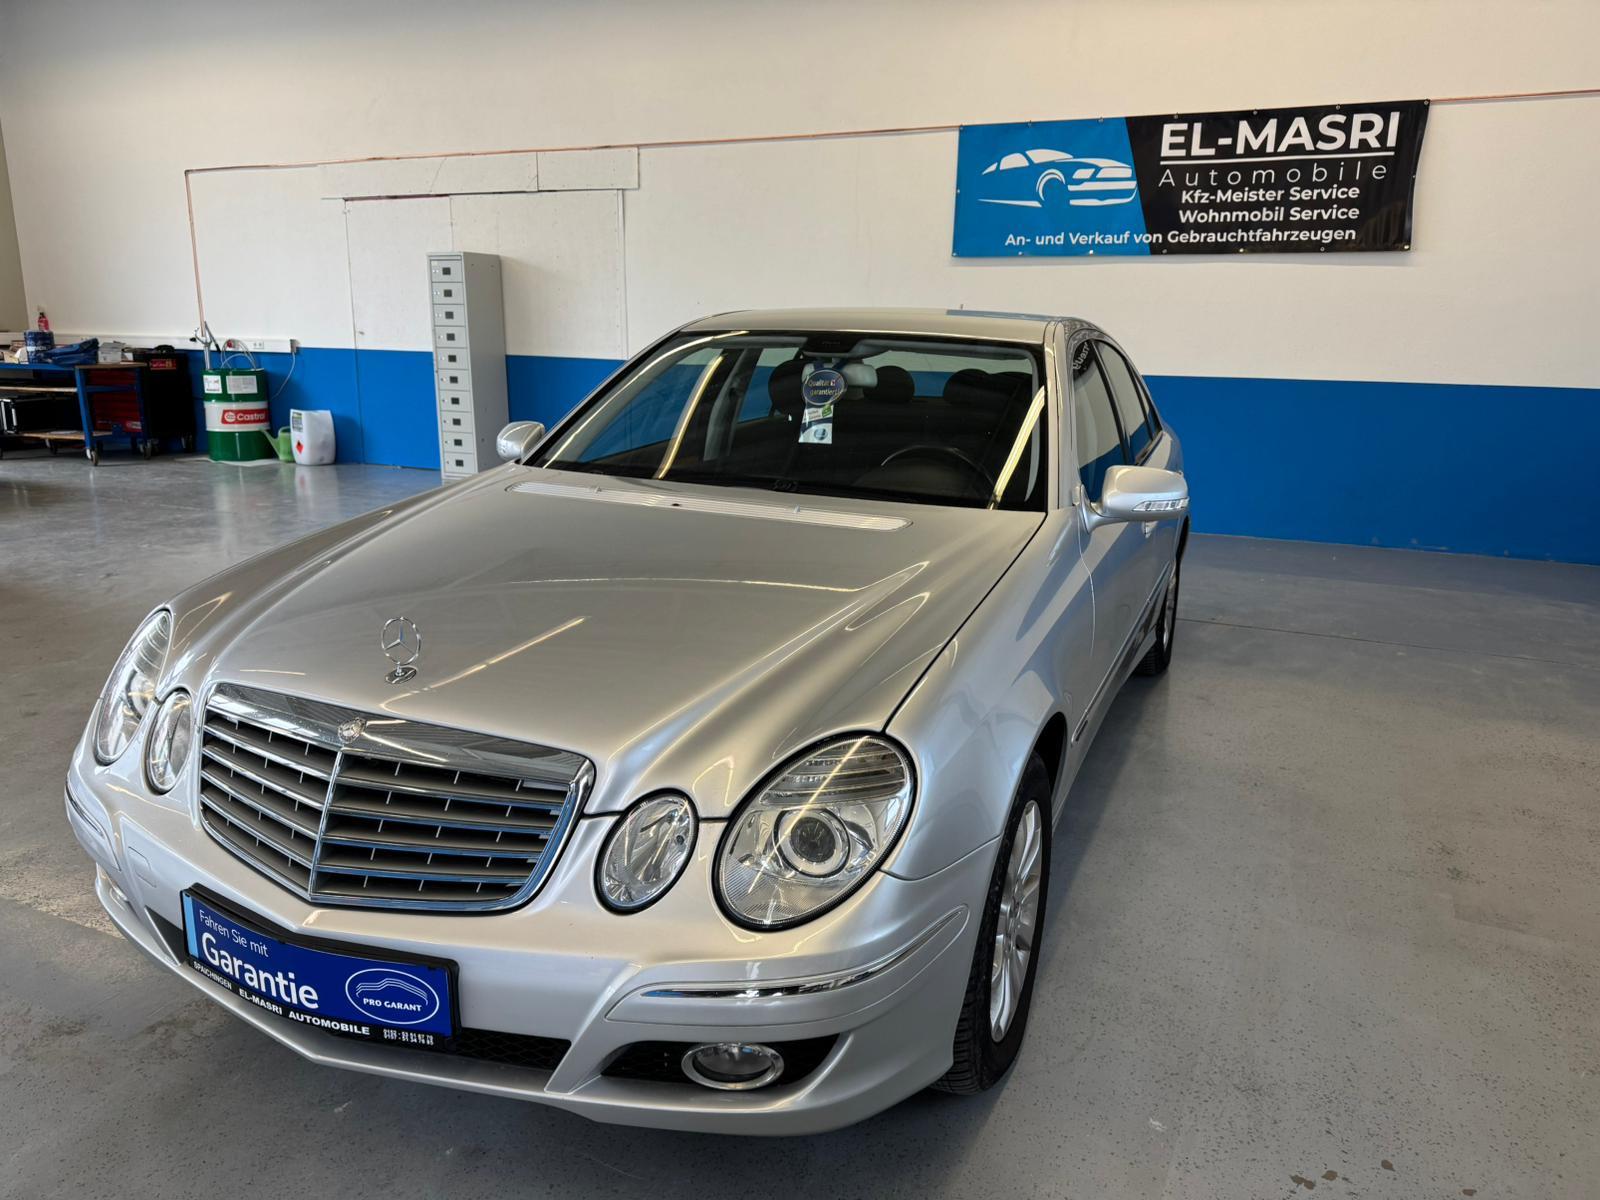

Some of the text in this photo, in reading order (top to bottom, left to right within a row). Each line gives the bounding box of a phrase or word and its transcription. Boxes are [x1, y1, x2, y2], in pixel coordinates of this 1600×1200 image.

[1160, 110, 1400, 158] EL-MASRI
[1158, 164, 1388, 187] Automobile
[1181, 185, 1361, 205] Kfz-Meister Service
[1178, 205, 1361, 225] Wohnmobil Service
[1004, 226, 1357, 247] An- und Verkauf von Gebrauchtfahrzeugen
[199, 909, 269, 958] Fahren Sie mit
[201, 932, 320, 1010] Garantie
[238, 988, 283, 1016] EL-MASRI
[288, 1011, 370, 1036] AUTOMOBILE
[362, 997, 423, 1013] PRO GARANT
